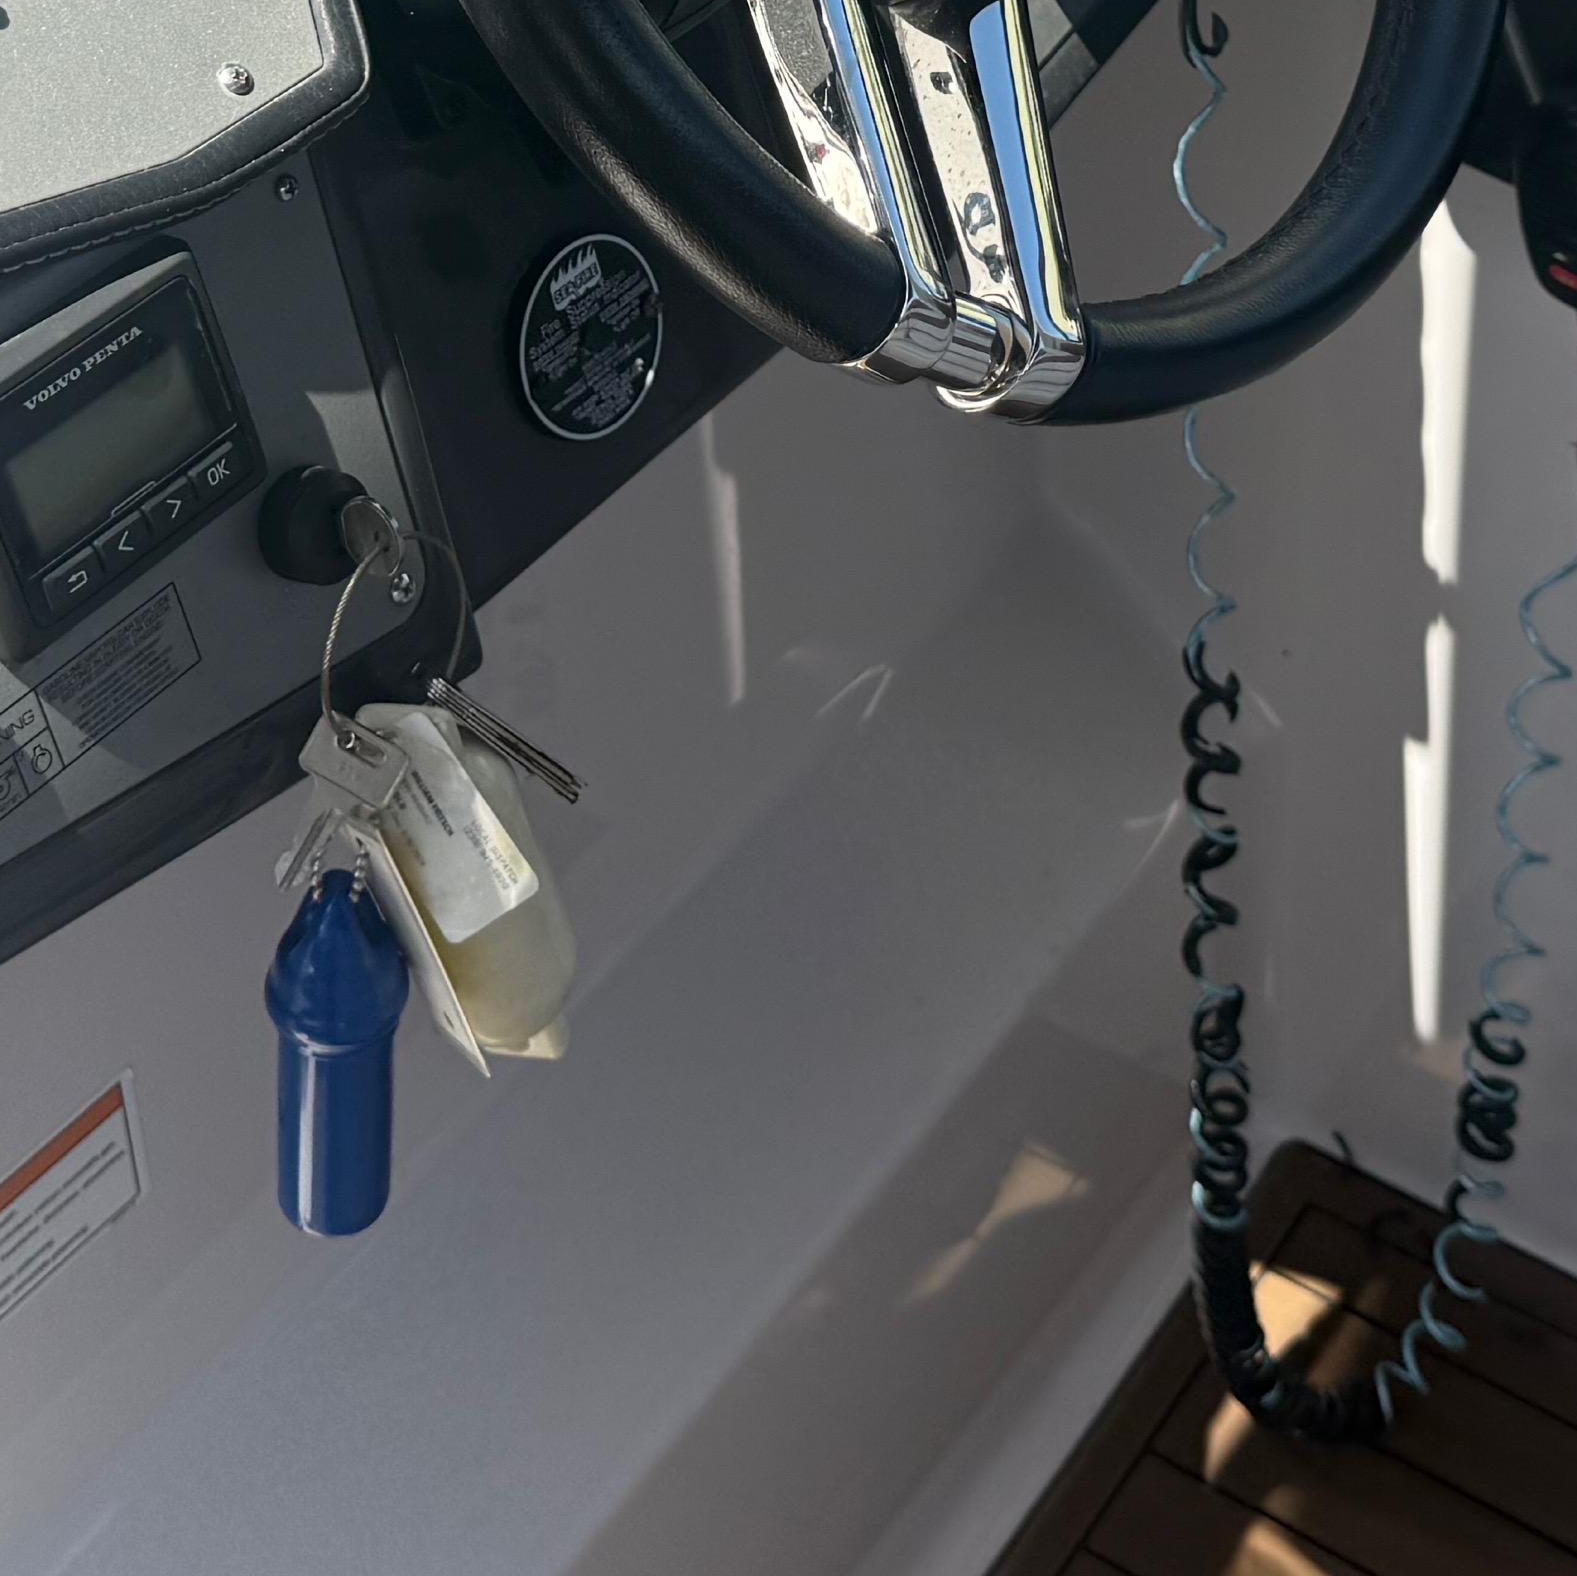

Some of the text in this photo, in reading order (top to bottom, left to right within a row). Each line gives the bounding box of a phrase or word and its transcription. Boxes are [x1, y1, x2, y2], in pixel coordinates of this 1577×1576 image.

[24, 326, 143, 411] VOLVO PENTA
[207, 458, 231, 486] OK
